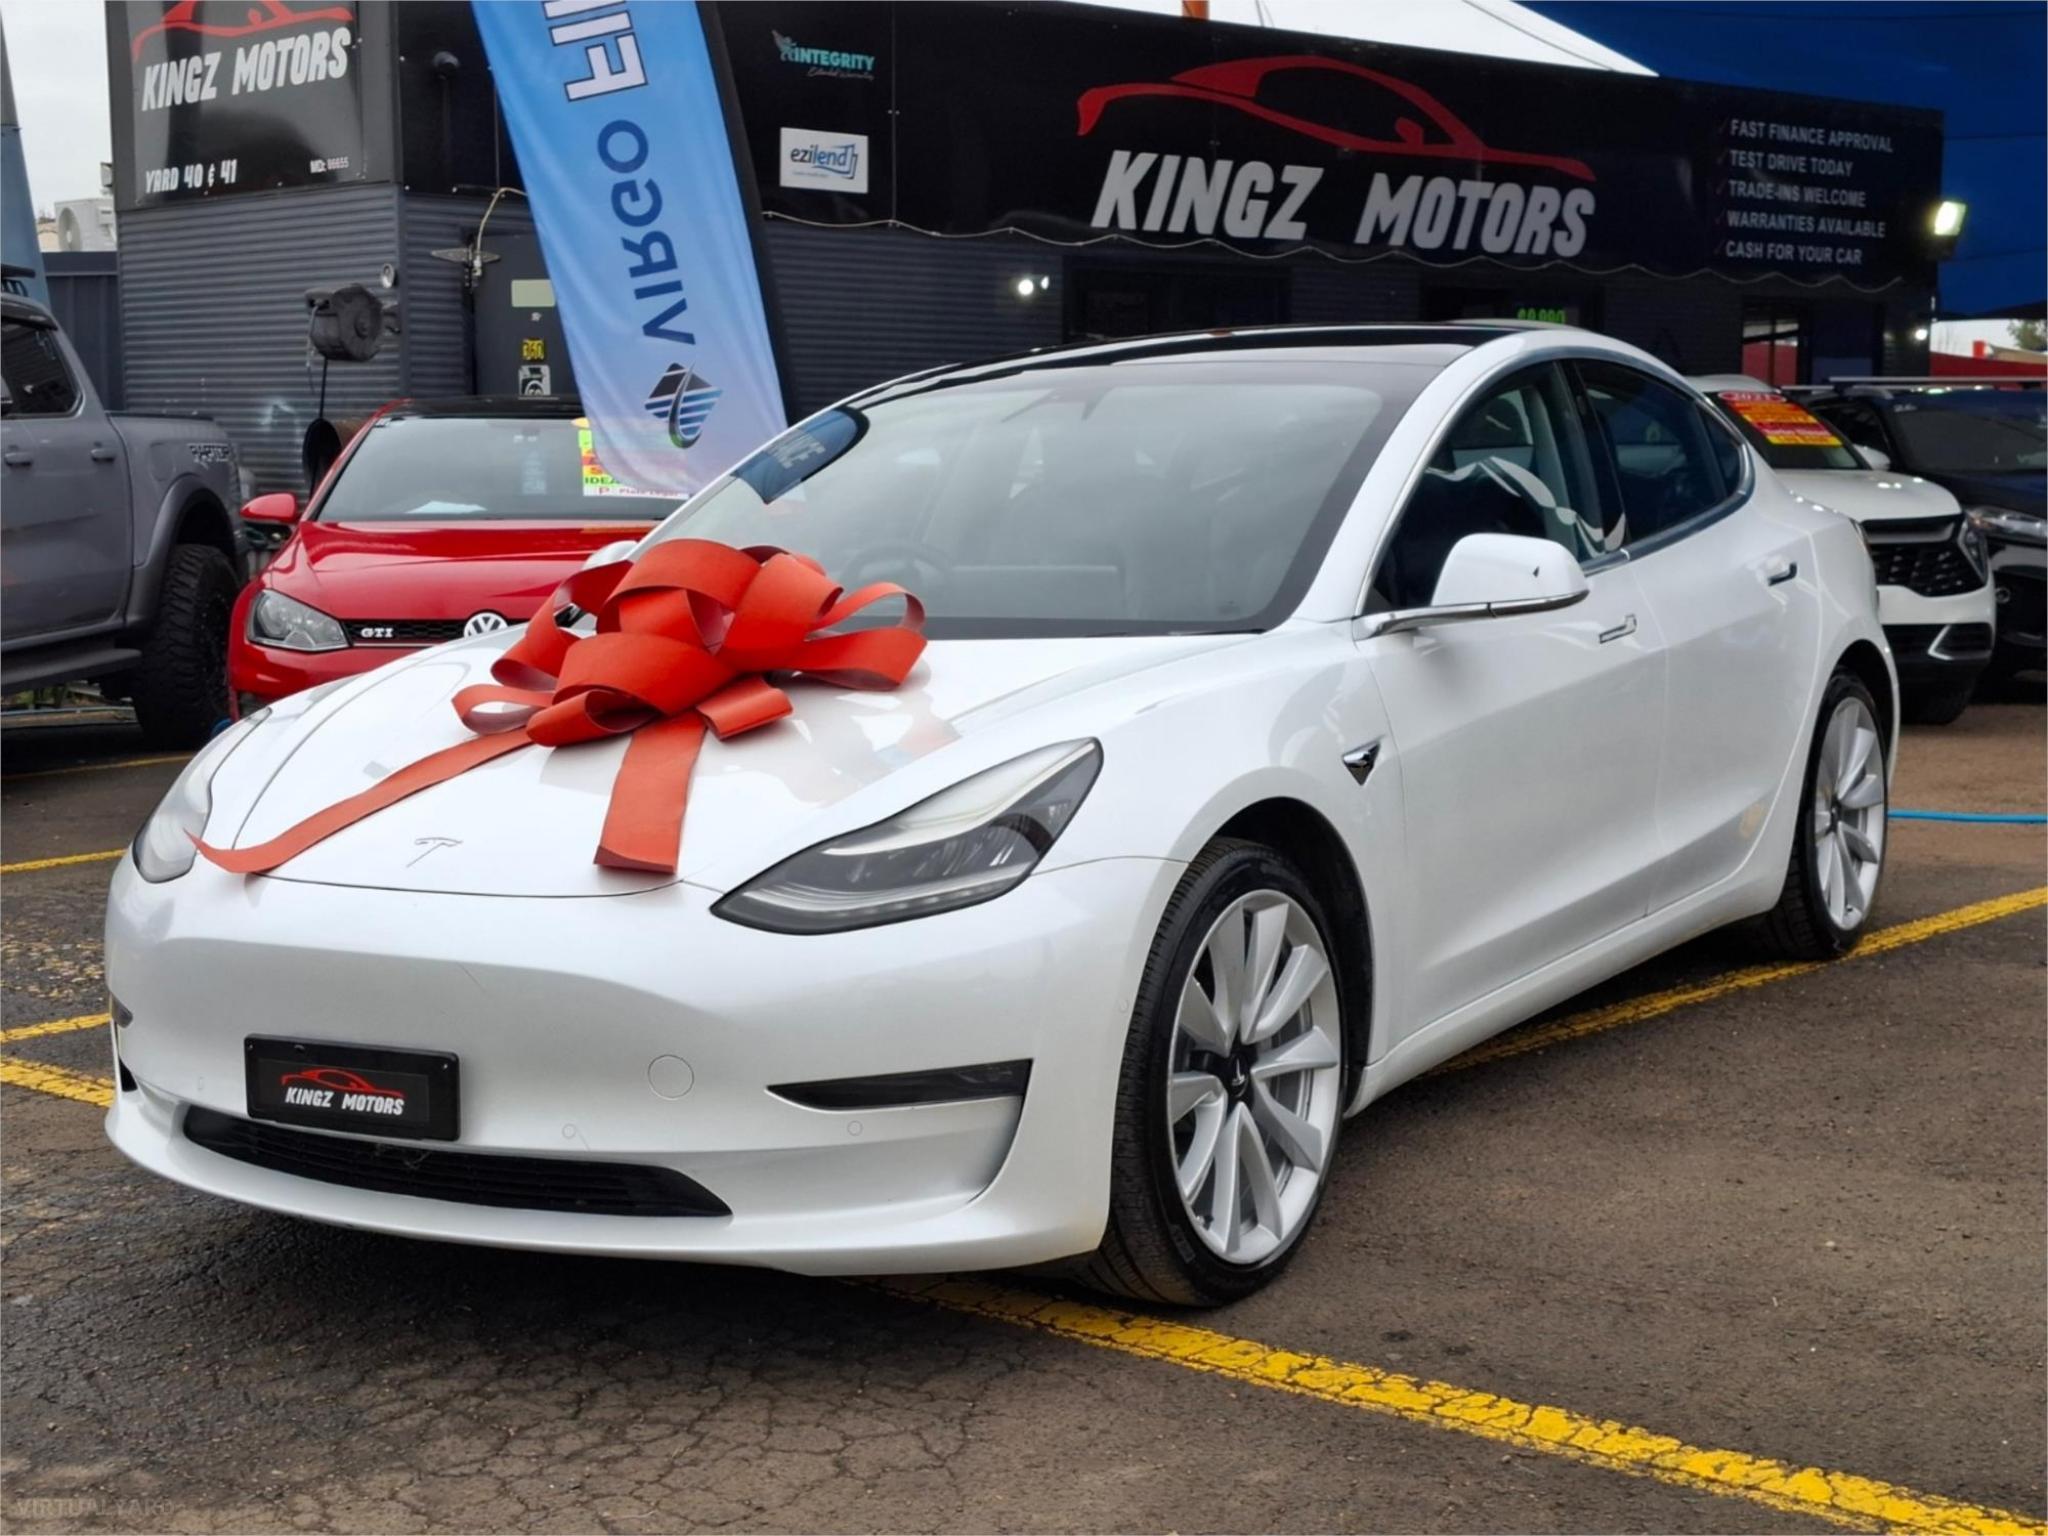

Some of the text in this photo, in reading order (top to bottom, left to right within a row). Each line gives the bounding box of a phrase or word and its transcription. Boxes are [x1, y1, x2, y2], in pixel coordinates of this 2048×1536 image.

[141, 26, 352, 112] KINGZ MOTORS
[795, 46, 876, 71] INTEGRITY
[1730, 119, 1894, 153] FAST FINANCE APPROVAL
[790, 144, 848, 166] ezilend
[1730, 149, 1854, 177] TEST DRIVE TODAY
[145, 166, 180, 194] YARD
[184, 163, 204, 189] 40
[220, 159, 238, 184] 41
[1090, 149, 1596, 258] KINGZ MOTORS
[1728, 180, 1867, 208] TRADE-INS WELCOME
[1727, 210, 1886, 238] WARRANTIES AVAILABLE
[1726, 240, 1862, 265] CASH FOR YOUR CAR
[360, 627, 394, 638] GTI
[285, 1086, 405, 1116] KINGZ MOTORS
